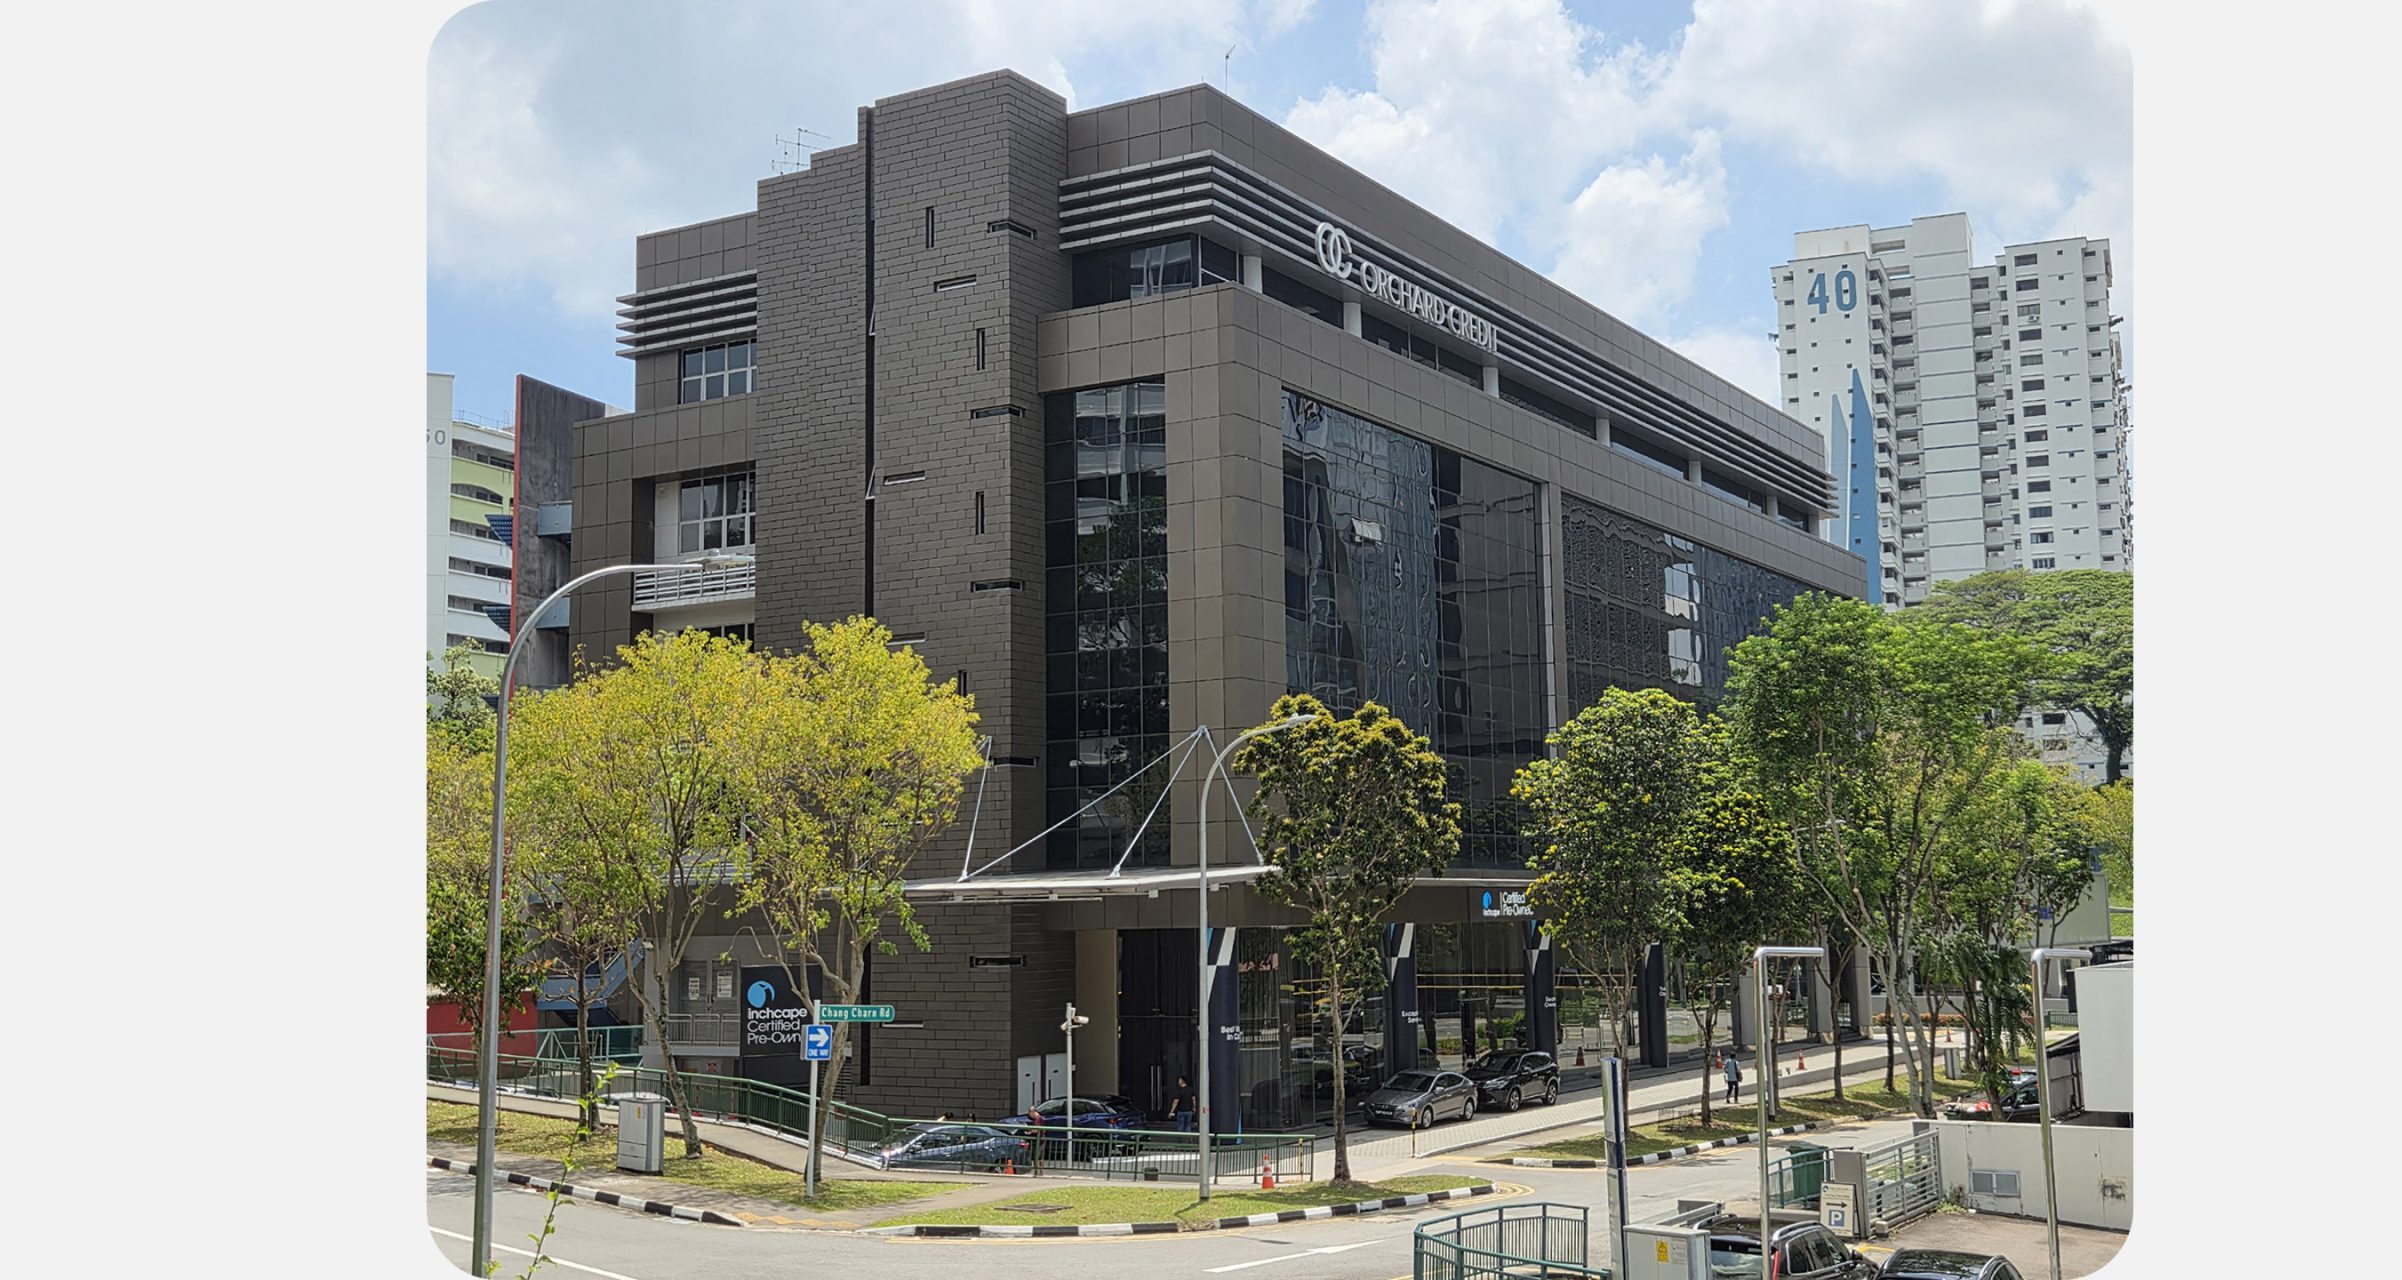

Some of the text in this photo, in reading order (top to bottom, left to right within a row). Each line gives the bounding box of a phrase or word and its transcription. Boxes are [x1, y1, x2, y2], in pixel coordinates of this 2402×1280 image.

[1807, 270, 1857, 314] 40
[1360, 261, 1499, 352] ORCHARD CREDIT
[1503, 892, 1526, 904] Certified
[748, 1008, 807, 1019] inchcape
[821, 1007, 890, 1020] Chang Charn Rd
[747, 1019, 800, 1032] Certified
[808, 1049, 818, 1057] ONE
[1831, 1211, 1842, 1225] P
